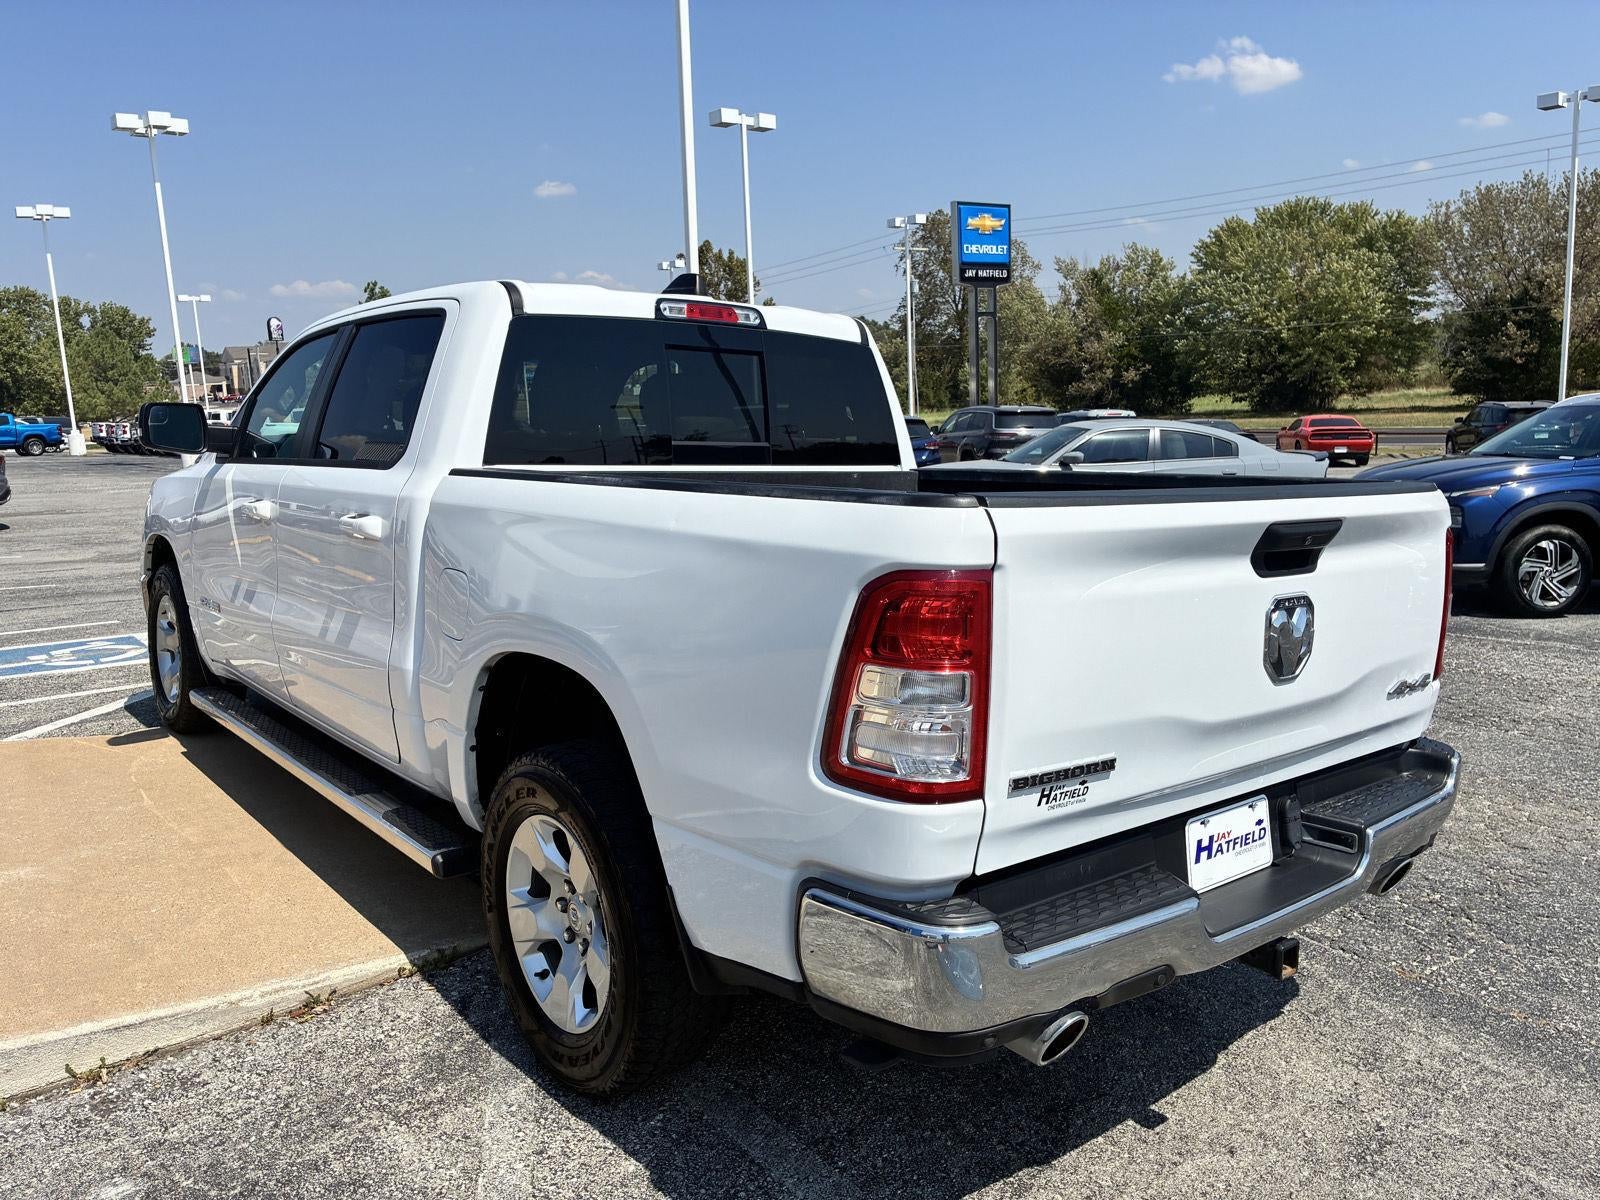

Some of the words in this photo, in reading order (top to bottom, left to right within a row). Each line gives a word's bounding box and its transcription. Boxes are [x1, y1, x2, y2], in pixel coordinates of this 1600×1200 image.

[963, 244, 1008, 255] CHEVROLET
[964, 269, 977, 278] JAY
[978, 269, 1008, 278] HATFIELD
[1053, 783, 1067, 793] JAY
[1036, 785, 1090, 807] HATFIELD
[1047, 800, 1073, 812] CHEVROLET
[1215, 829, 1233, 844] JAY
[1194, 826, 1267, 865] HATFIELD
